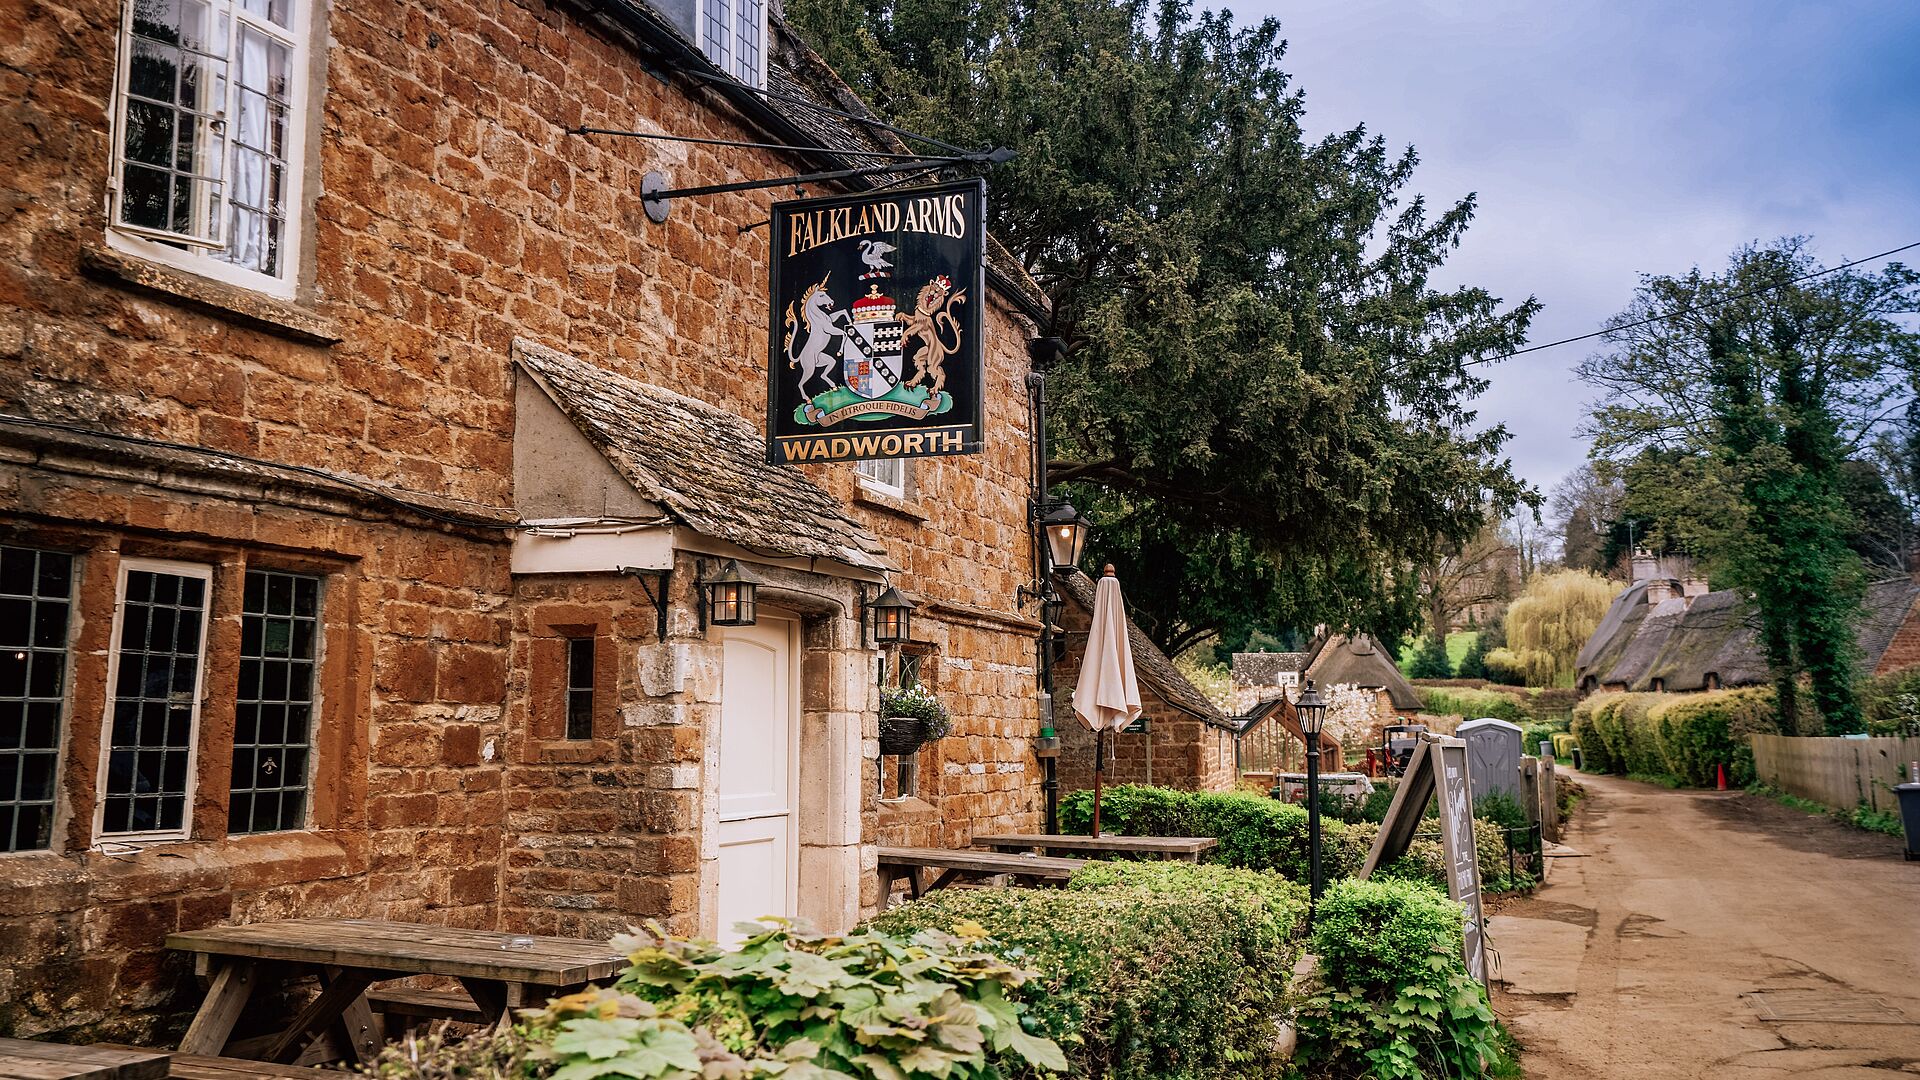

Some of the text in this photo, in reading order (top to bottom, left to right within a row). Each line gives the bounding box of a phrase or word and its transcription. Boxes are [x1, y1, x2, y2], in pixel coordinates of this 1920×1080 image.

[788, 194, 965, 257] FALKLAND ARMS
[829, 402, 917, 422] IN UTROQUE FIDELIS
[782, 430, 963, 461] WADWORTH
